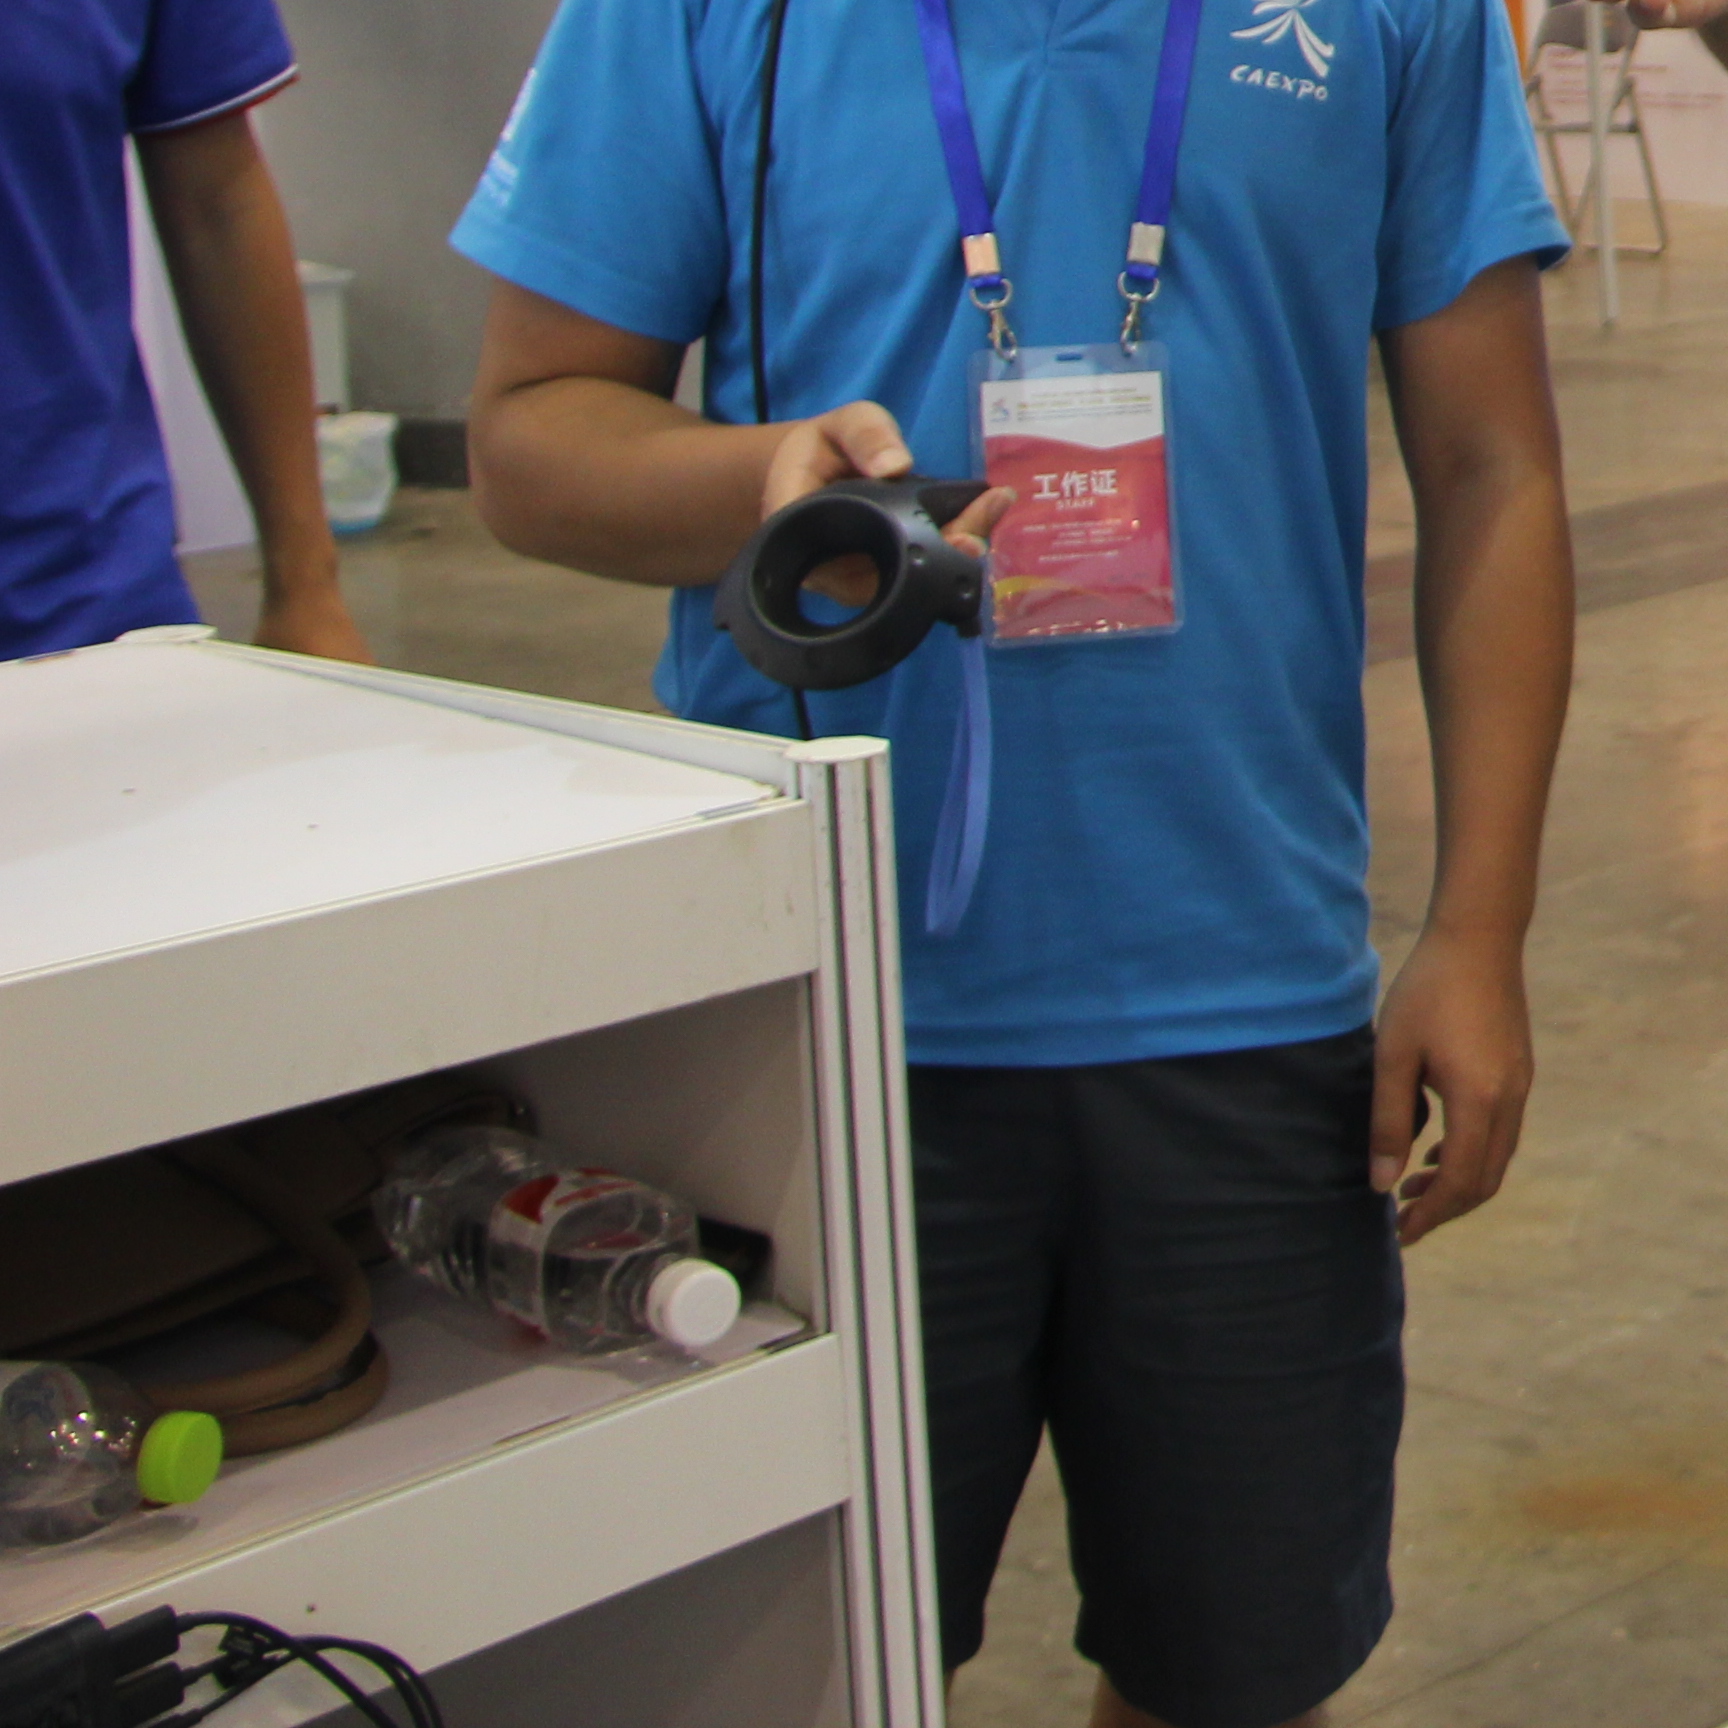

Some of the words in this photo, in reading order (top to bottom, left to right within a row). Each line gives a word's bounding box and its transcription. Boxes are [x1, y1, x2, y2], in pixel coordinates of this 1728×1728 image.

[1229, 64, 1329, 100] CAEXPO
[1032, 468, 1118, 499] 工作证
